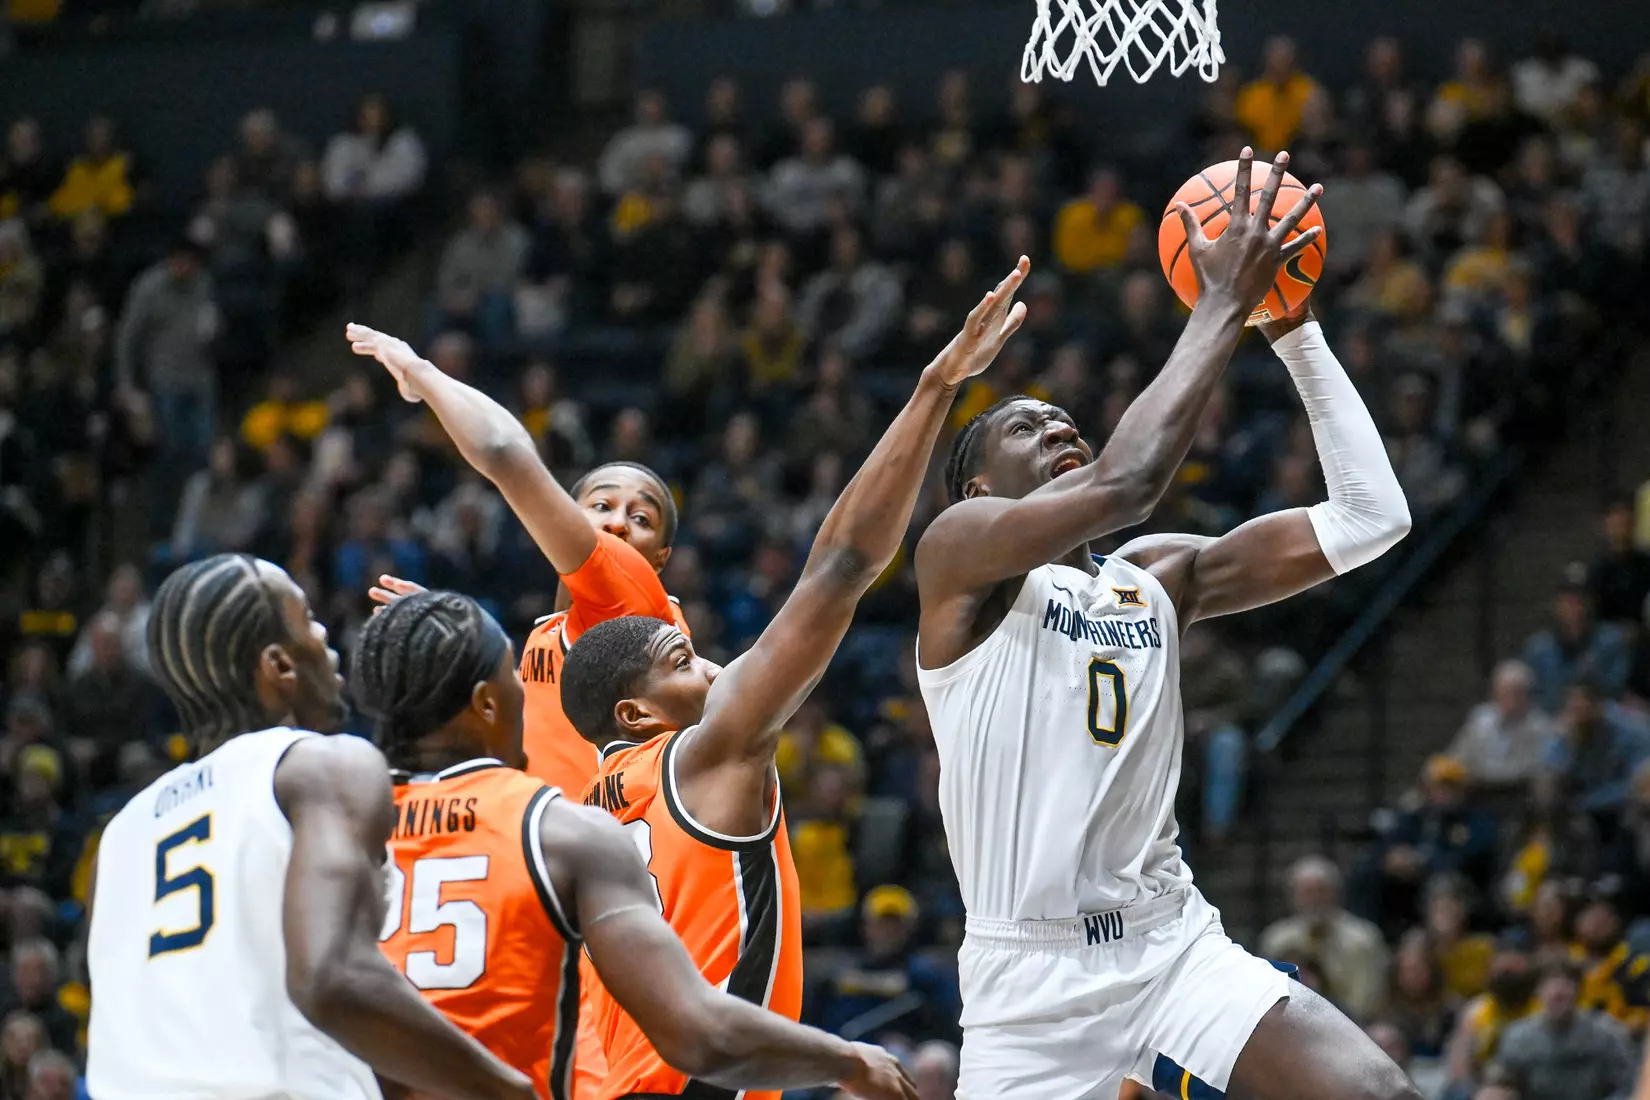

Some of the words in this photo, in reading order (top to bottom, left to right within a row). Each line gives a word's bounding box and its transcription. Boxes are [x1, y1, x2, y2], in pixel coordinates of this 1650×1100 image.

[1043, 598, 1162, 649] MOUNAINEERS
[520, 647, 556, 684] OMA
[1086, 656, 1129, 747] 0
[148, 809, 216, 960] 5
[1084, 911, 1124, 946] WVU
